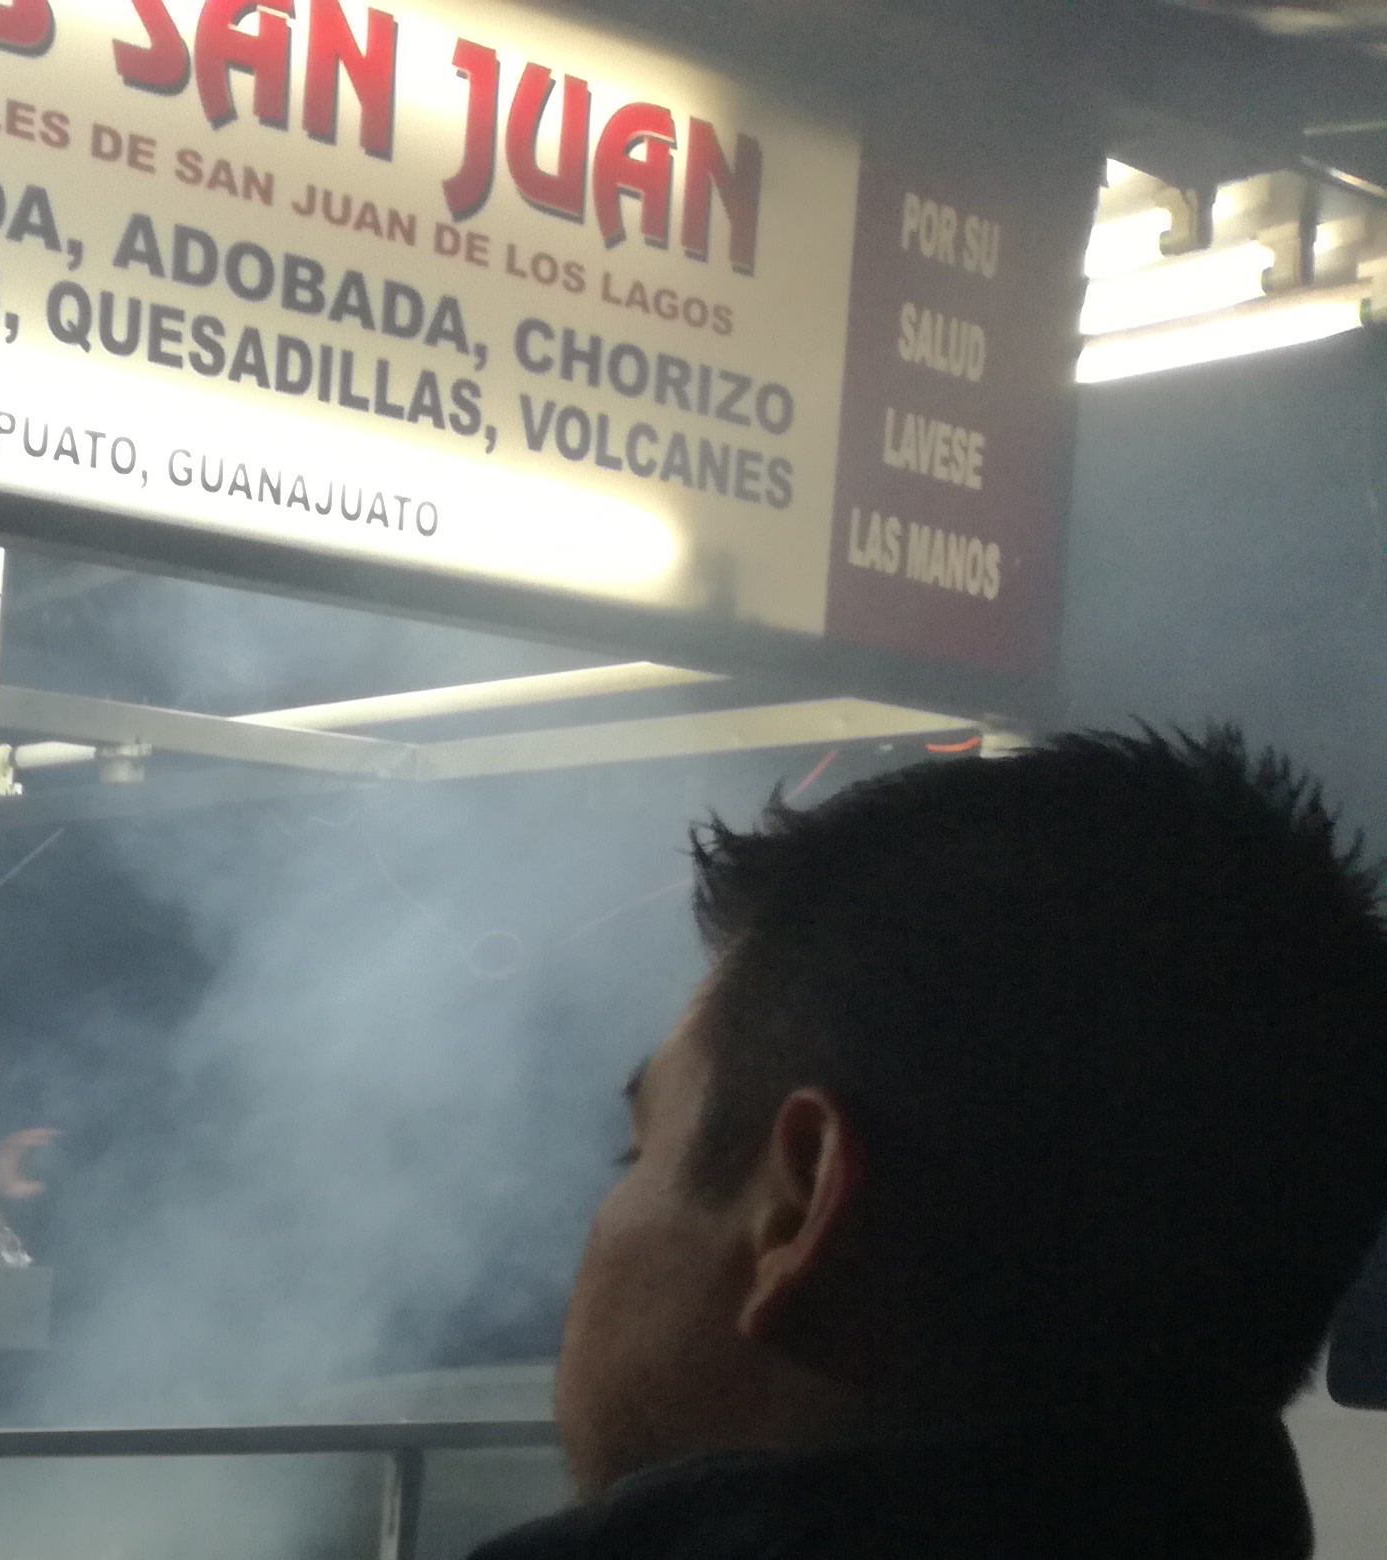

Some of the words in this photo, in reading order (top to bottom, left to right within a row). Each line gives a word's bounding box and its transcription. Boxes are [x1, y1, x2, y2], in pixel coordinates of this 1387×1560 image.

[442, 37, 763, 277] JUAN
[91, 123, 157, 174] DE
[175, 148, 274, 206] SAN
[291, 184, 417, 247] JUAN
[434, 223, 492, 268] DE
[505, 243, 587, 295] LOS
[601, 271, 735, 336] LAGOS
[900, 192, 958, 266] POR
[963, 215, 1002, 279] SU
[112, 213, 489, 371] ADOBADA,
[513, 317, 795, 436] CHORIZO
[898, 302, 986, 382] SALUD
[46, 280, 497, 455] QUESADILLAS,
[519, 393, 795, 511] VOLCANES
[168, 449, 439, 538] GUANAJUATO
[883, 406, 986, 490] LAVESE
[848, 506, 902, 575] LAS
[906, 521, 1002, 601] MANOS
